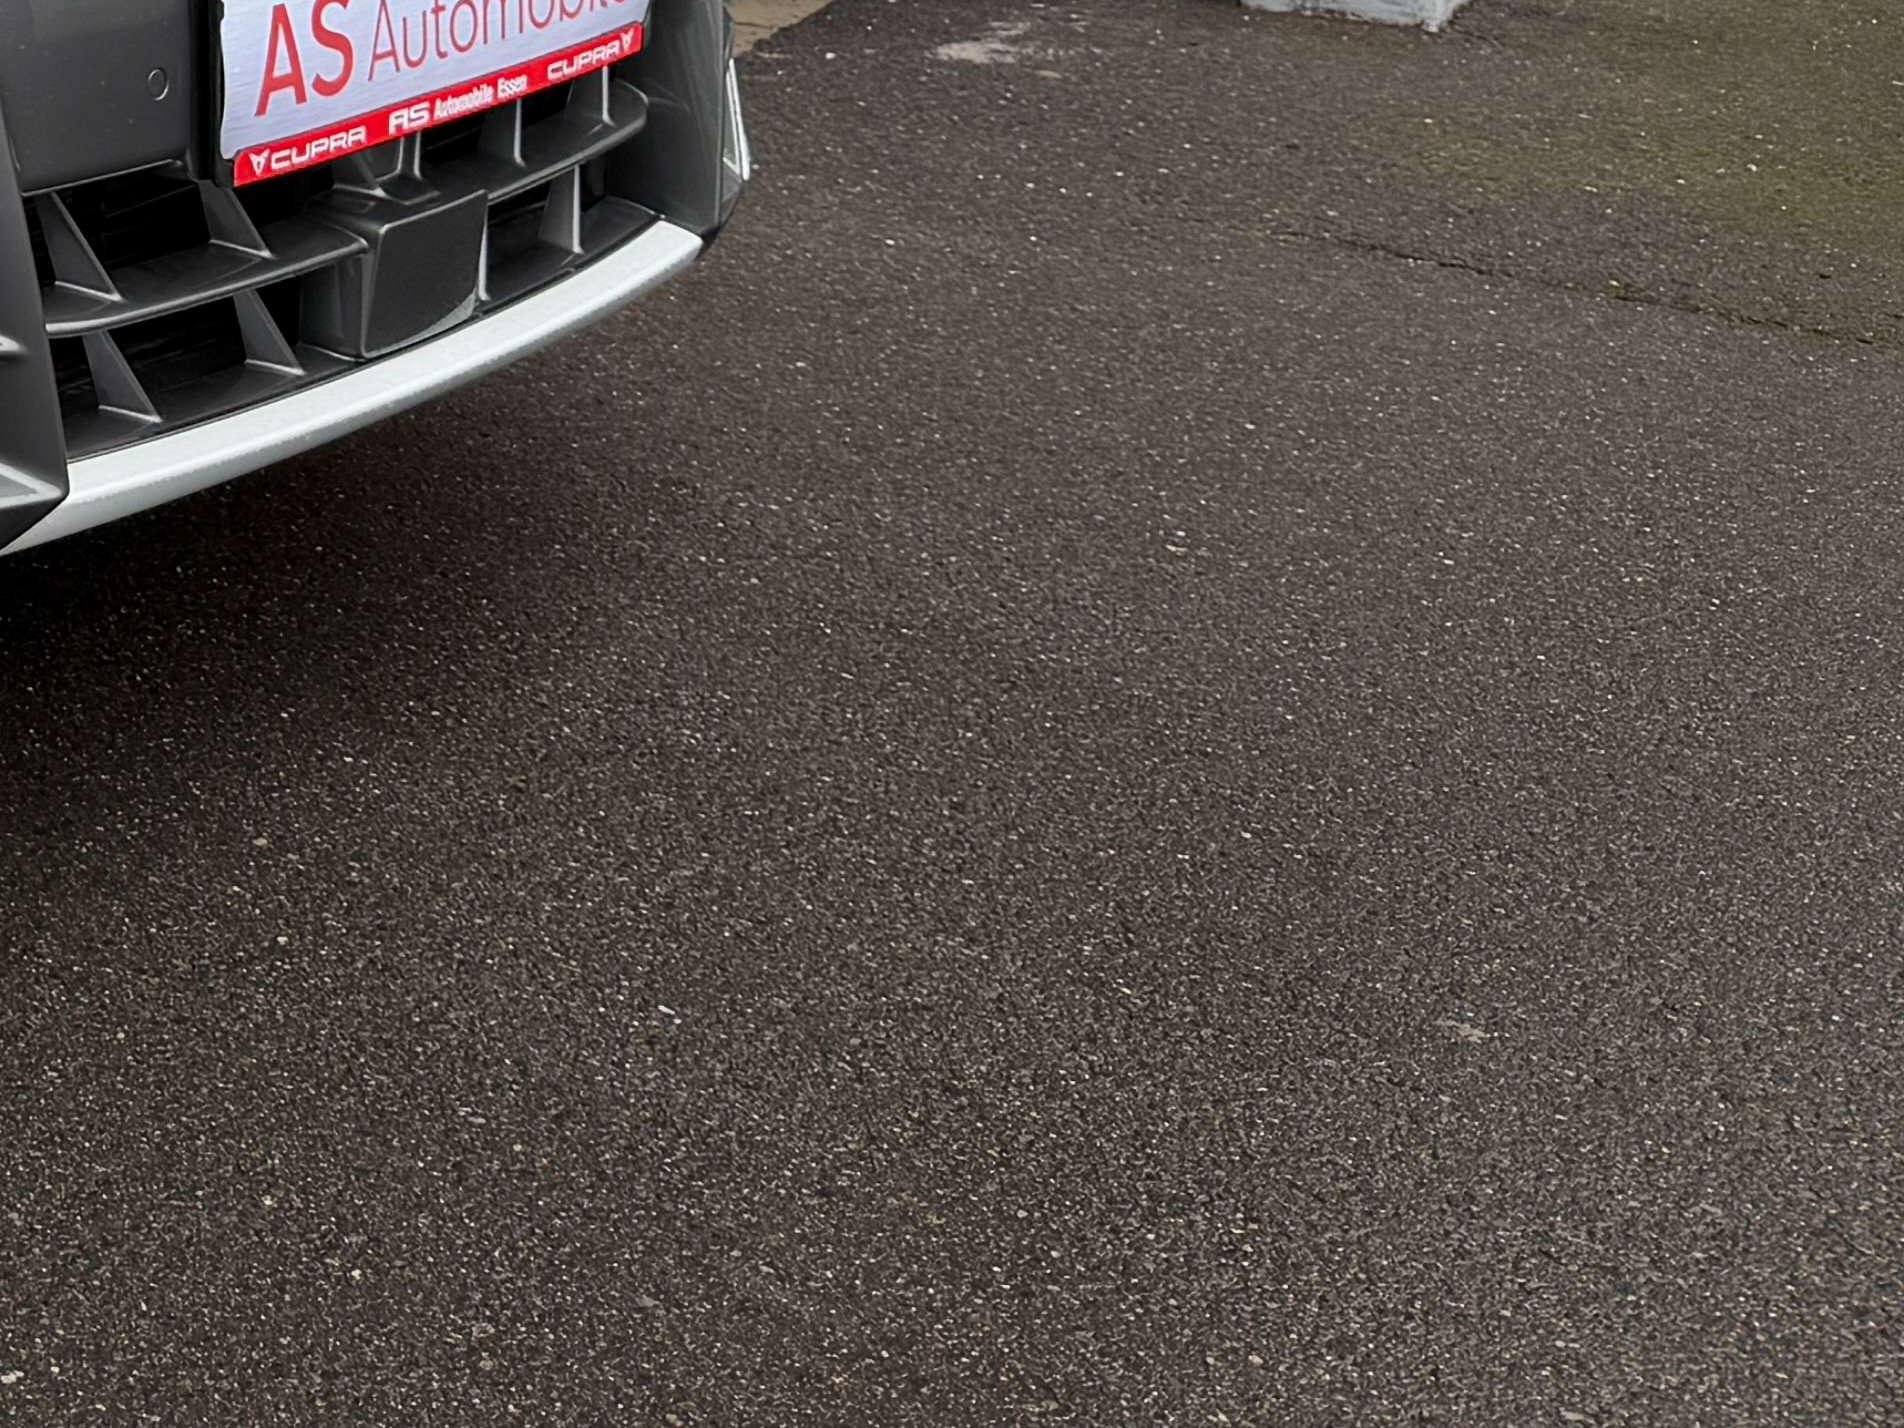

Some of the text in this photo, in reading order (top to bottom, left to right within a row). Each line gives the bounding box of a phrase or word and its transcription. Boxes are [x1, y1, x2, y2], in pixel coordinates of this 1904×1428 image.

[270, 124, 367, 170] CUPRA
[387, 101, 431, 135] AS
[433, 82, 494, 121] Automobile
[545, 37, 623, 81] CUPRA
